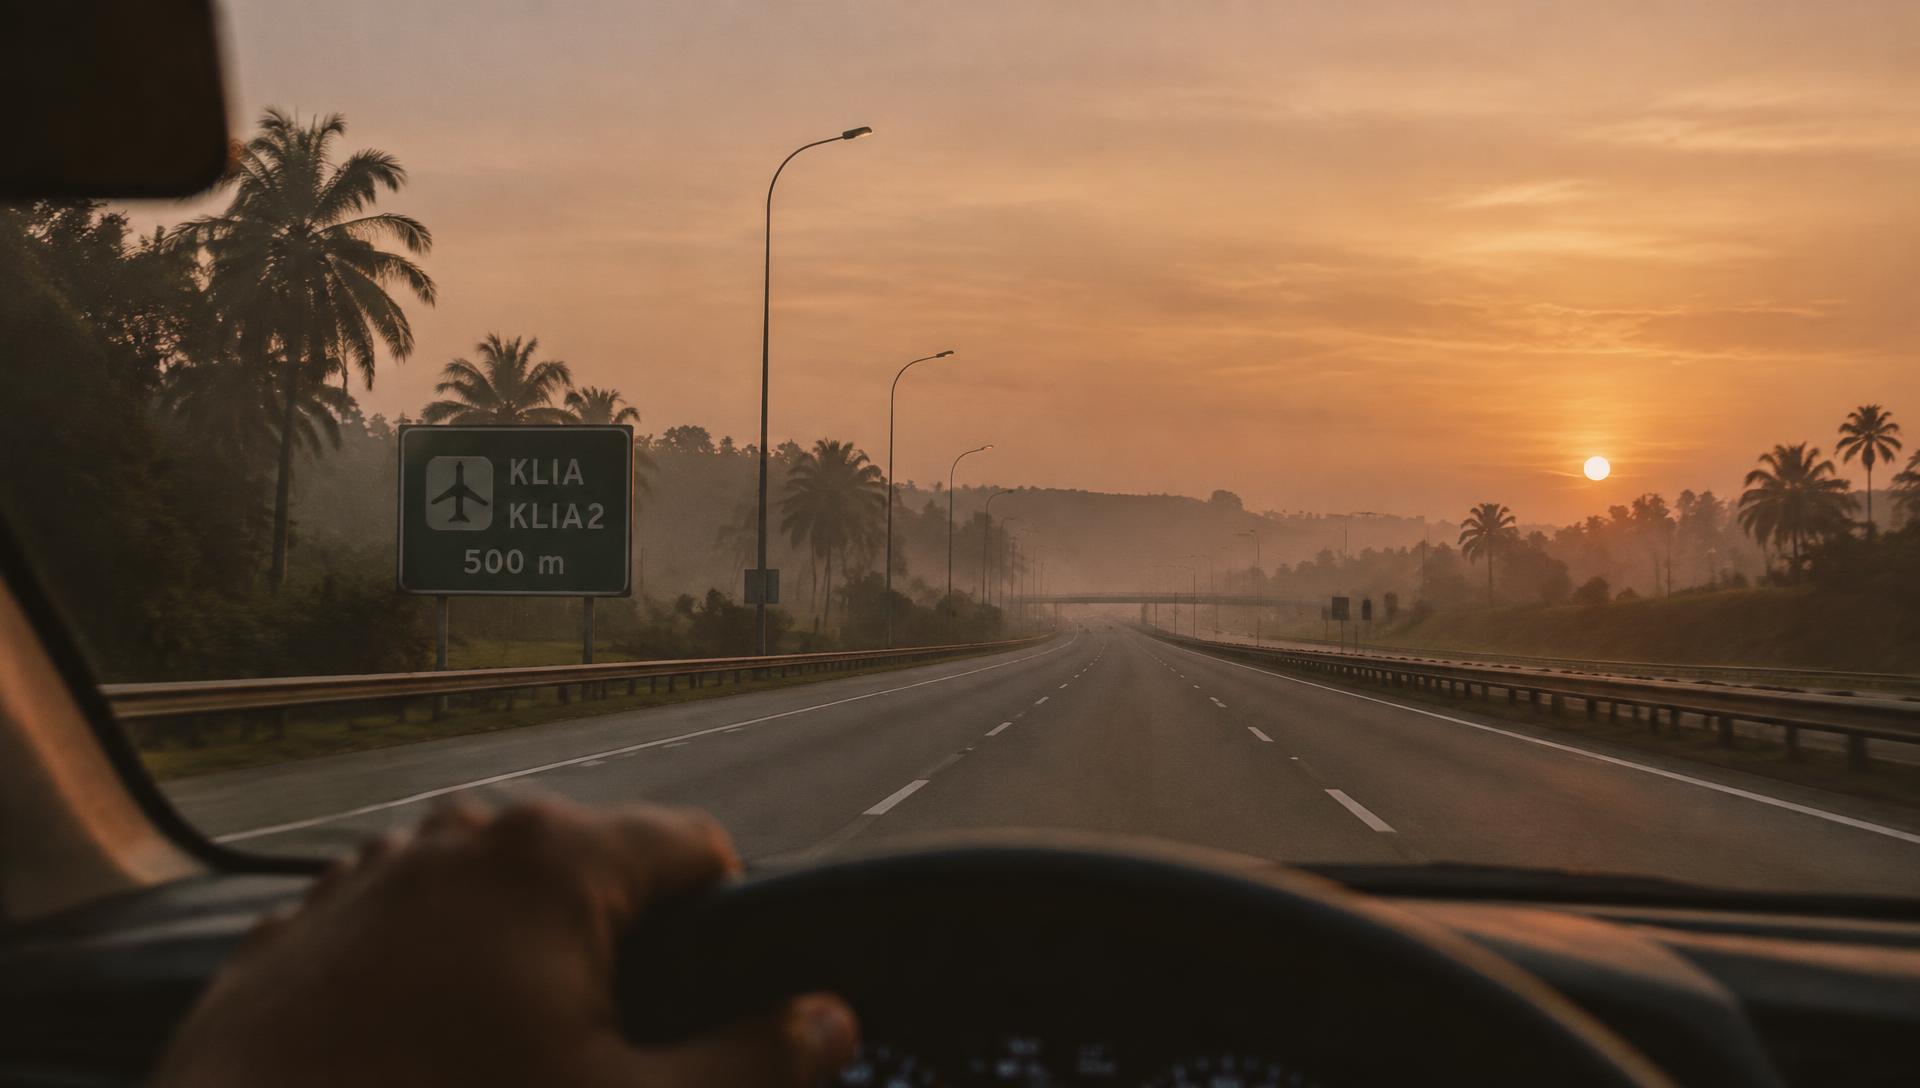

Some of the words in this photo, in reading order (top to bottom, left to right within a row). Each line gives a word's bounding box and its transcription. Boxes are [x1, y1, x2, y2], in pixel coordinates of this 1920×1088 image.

[509, 458, 584, 485] KLIA
[509, 502, 605, 529] KLIA2
[463, 549, 525, 575] 500
[538, 554, 564, 575] m
